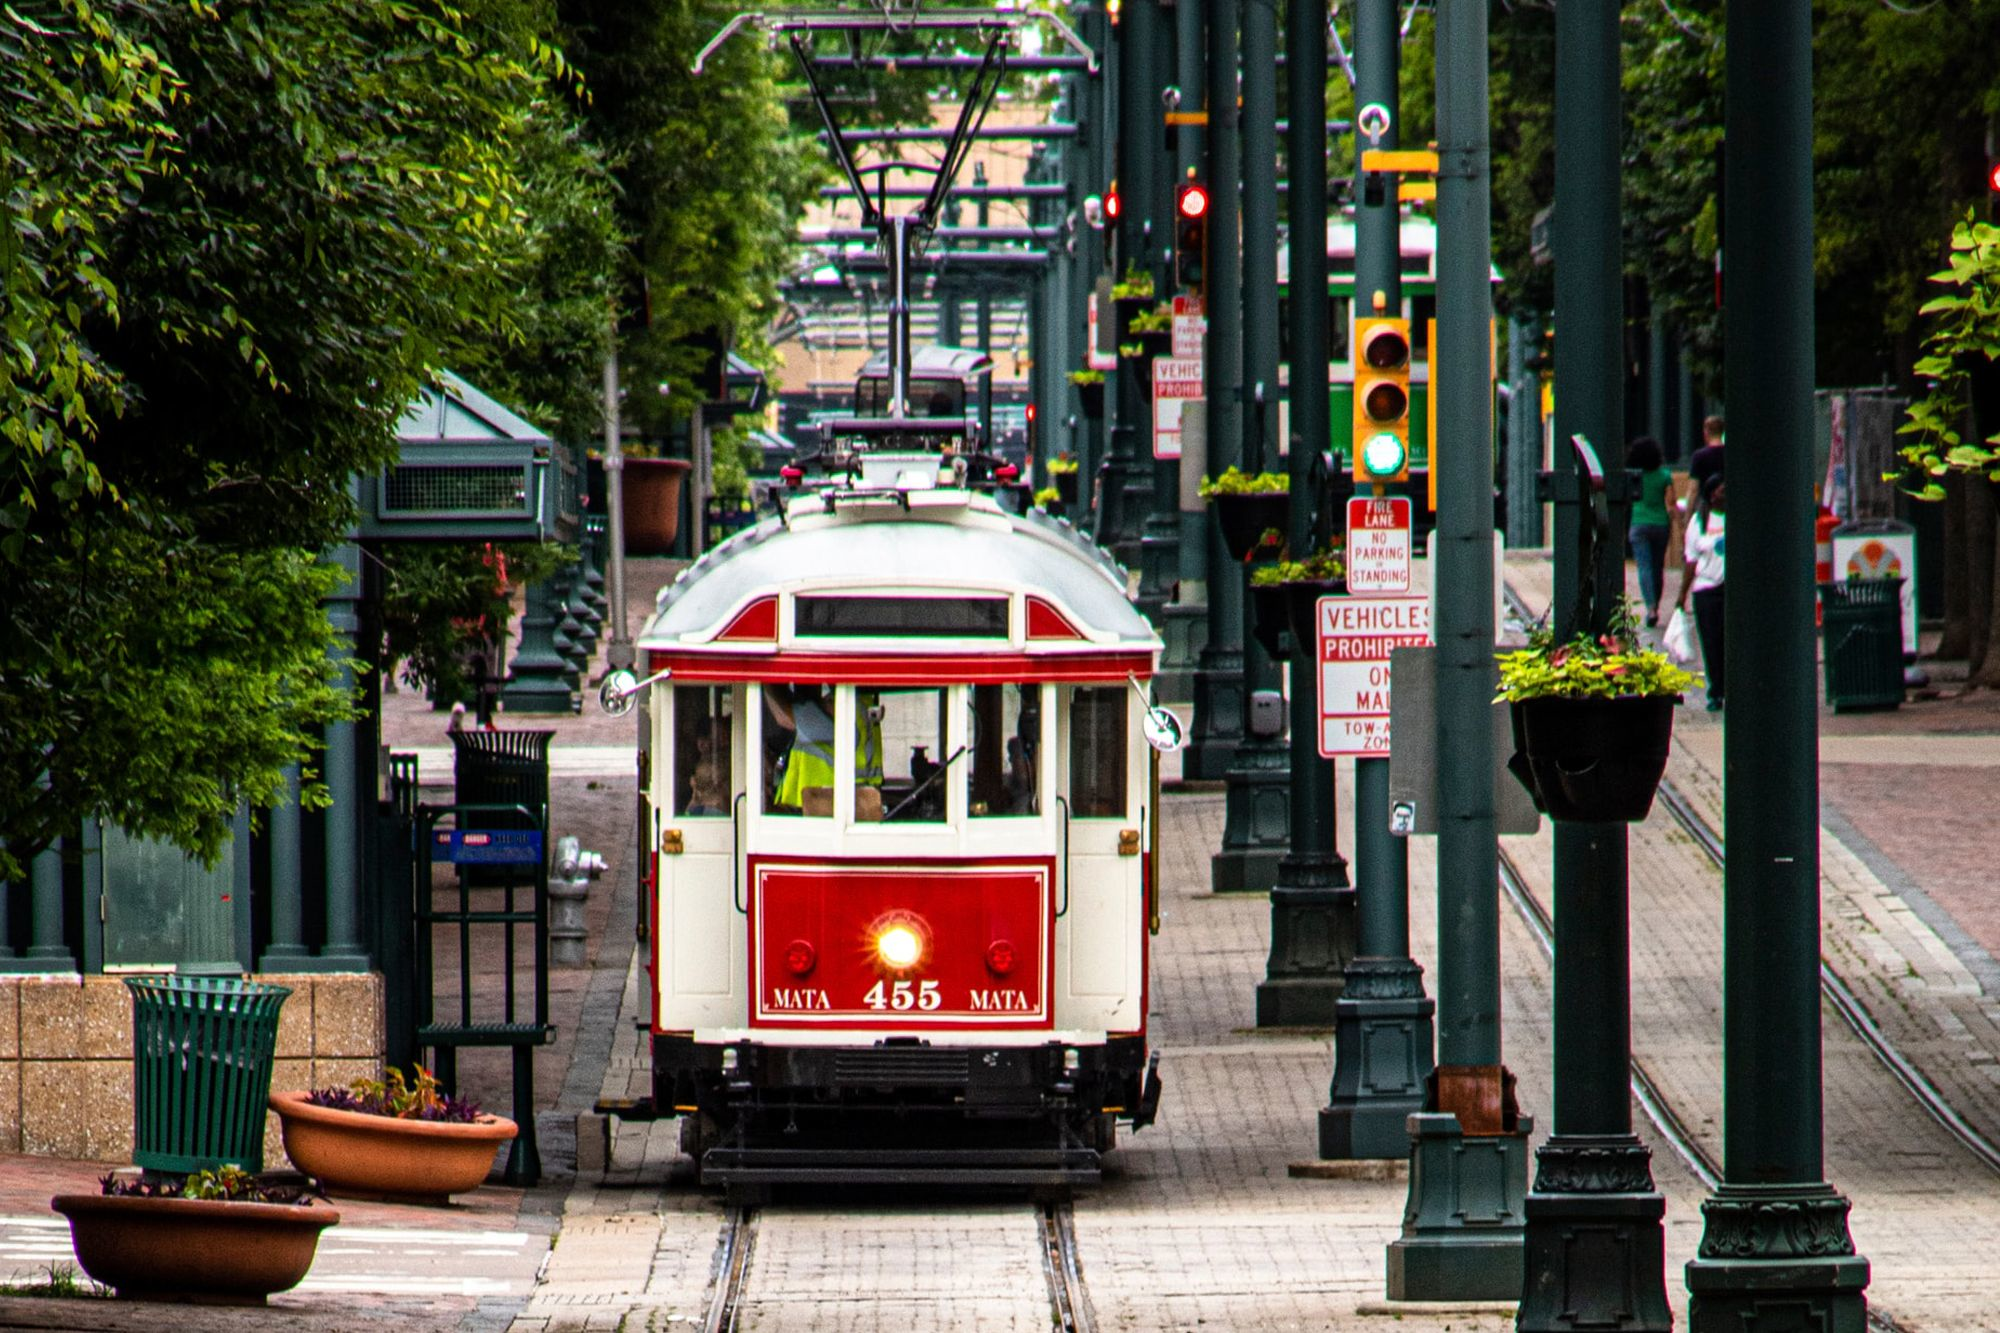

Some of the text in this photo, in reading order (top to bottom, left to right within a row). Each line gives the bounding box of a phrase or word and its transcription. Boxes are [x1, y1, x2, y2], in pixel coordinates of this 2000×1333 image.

[1160, 363, 1201, 378] VEHIC
[1366, 500, 1393, 513] FIRE
[1364, 514, 1395, 528] LANE
[1371, 532, 1387, 544] NO
[1355, 547, 1404, 560] PARKING
[1353, 569, 1407, 583] STANDING
[1345, 721, 1391, 736] TOW-A
[1363, 737, 1391, 750] ZON
[773, 979, 1029, 1011] MATA 455 MATA
